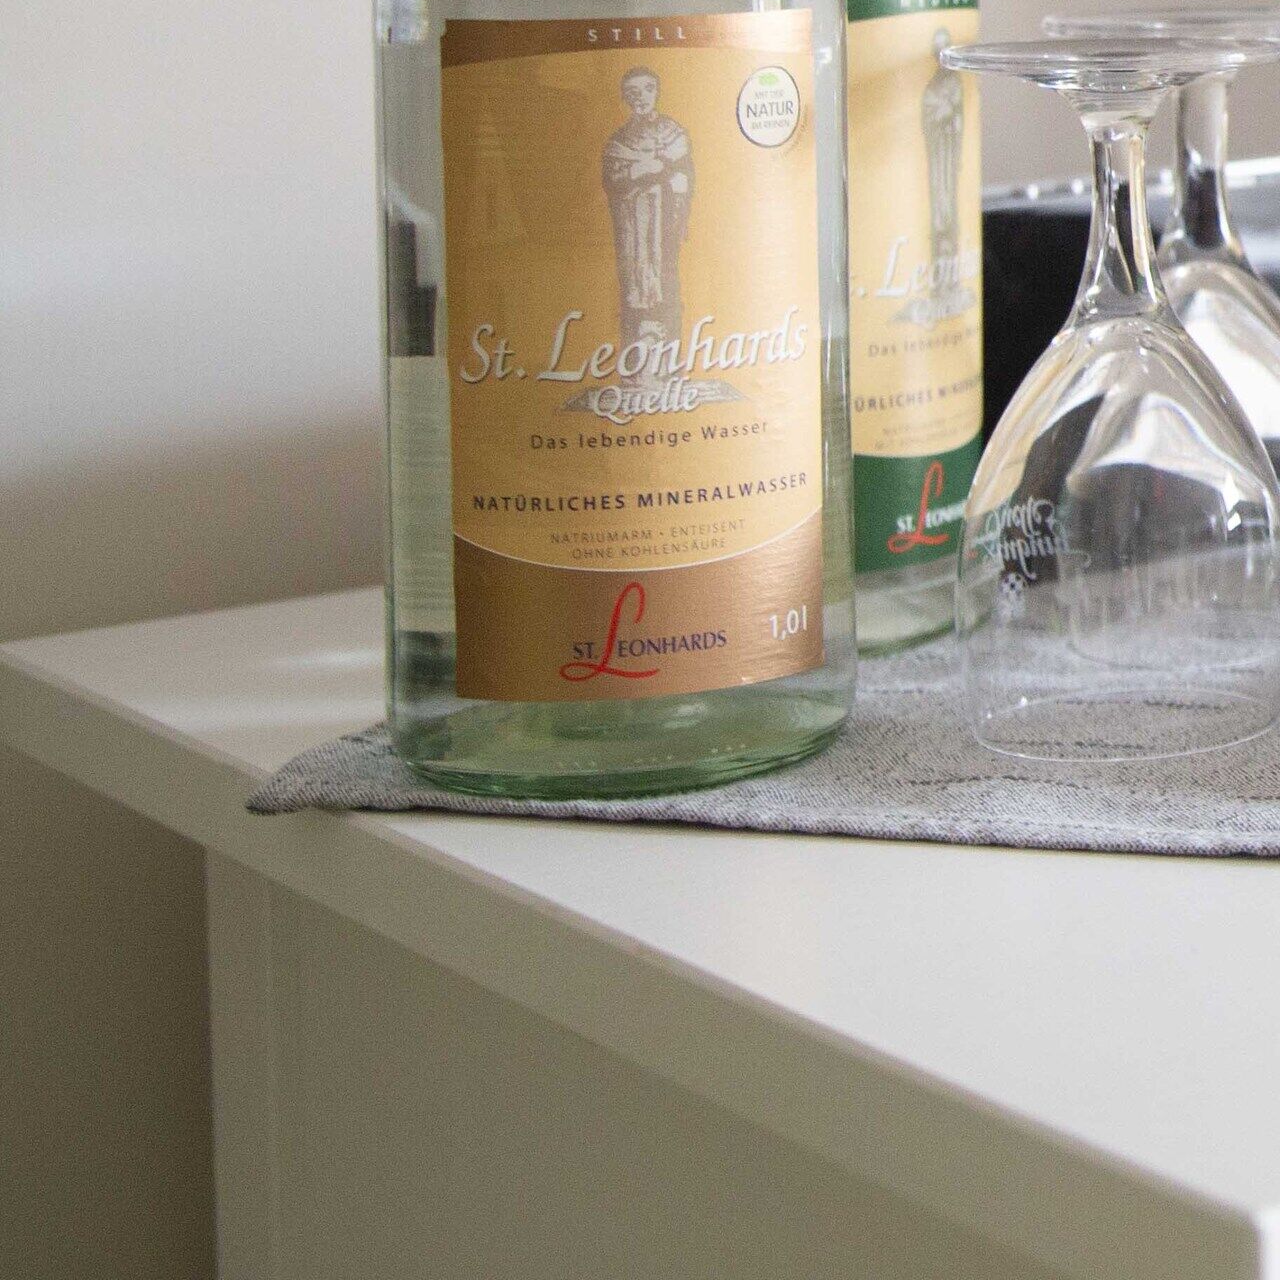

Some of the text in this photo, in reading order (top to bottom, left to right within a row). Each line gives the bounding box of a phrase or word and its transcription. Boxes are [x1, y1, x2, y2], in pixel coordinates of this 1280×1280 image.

[587, 26, 688, 42] STILL
[746, 101, 794, 118] NATUR
[460, 305, 807, 383] St. Leonhards
[588, 375, 702, 425] Quelle
[530, 419, 769, 451] Das lebendige Wasser
[473, 472, 807, 513] NATÜRLICHES MINERALWASSER
